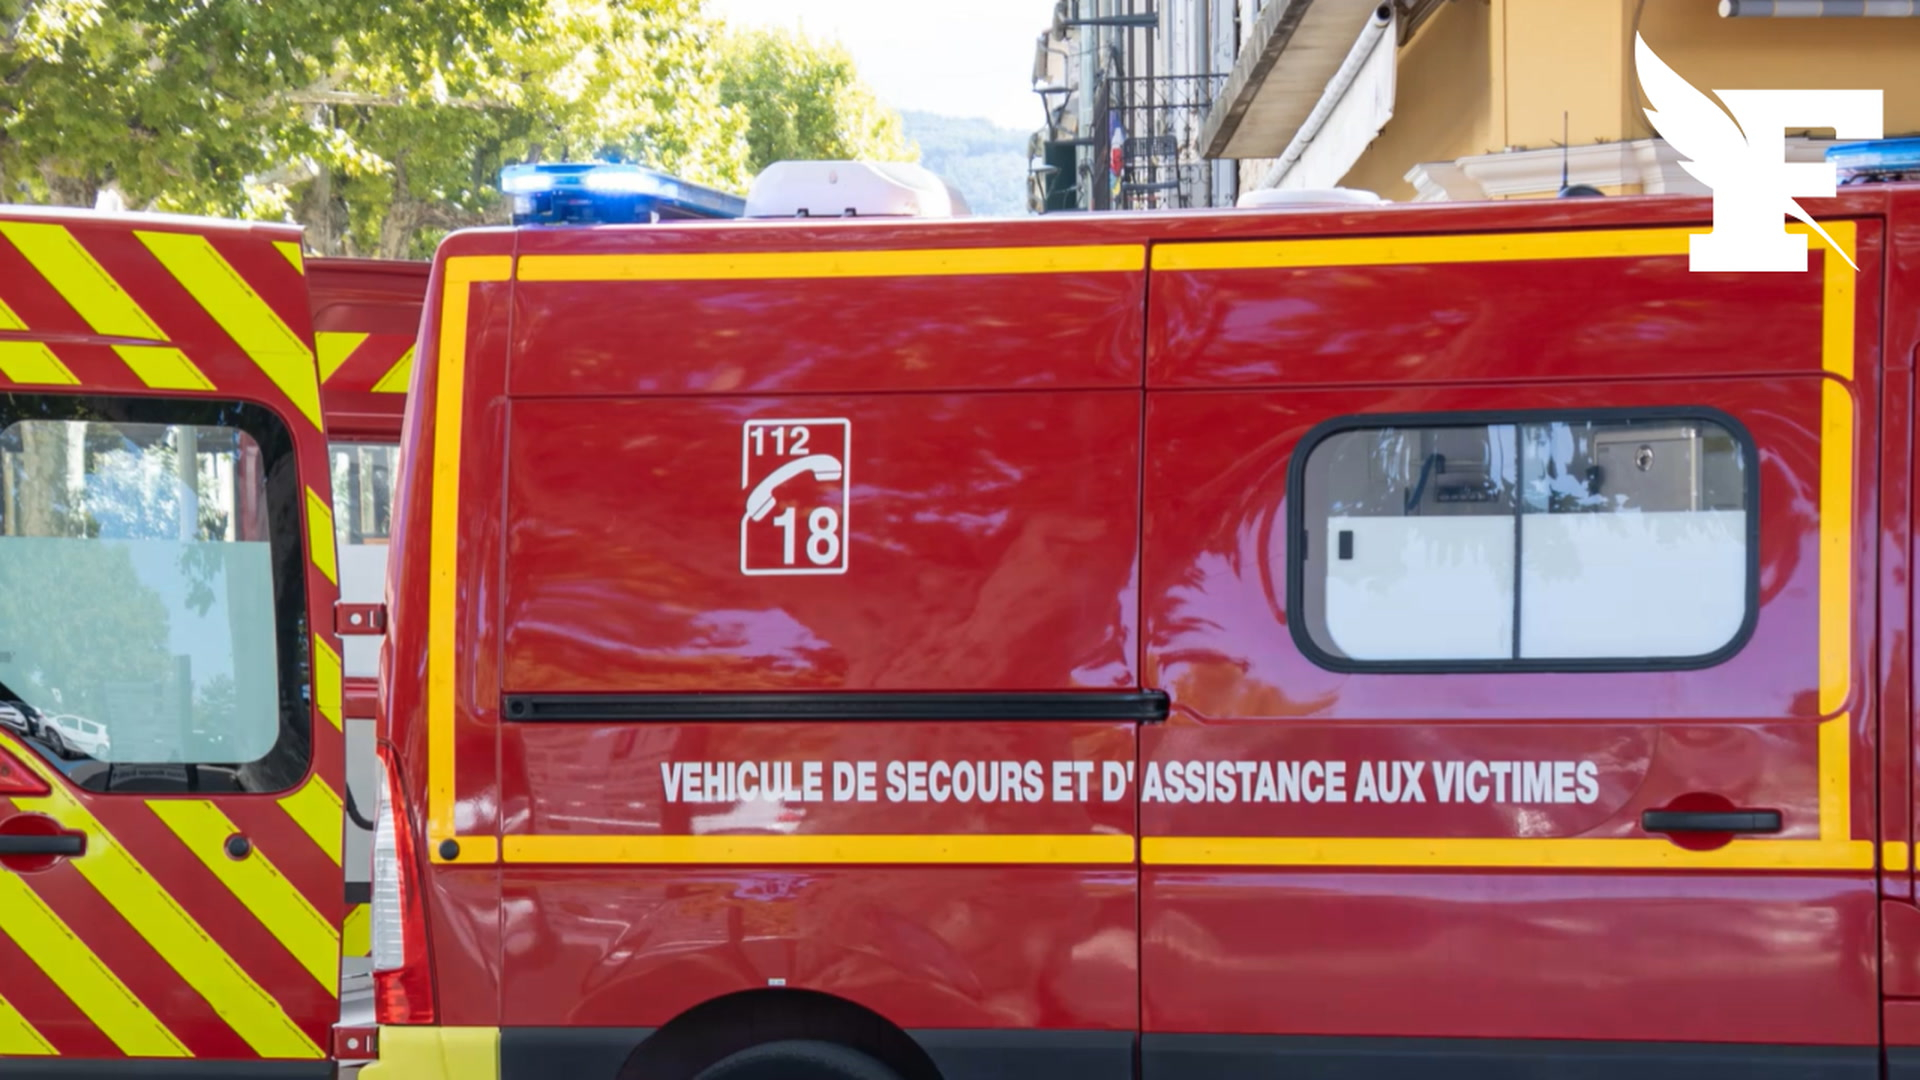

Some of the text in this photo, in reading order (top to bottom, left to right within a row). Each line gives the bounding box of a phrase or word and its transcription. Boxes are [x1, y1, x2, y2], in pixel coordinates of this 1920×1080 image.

[750, 426, 810, 456] 112
[773, 506, 839, 565] 18
[661, 761, 823, 802] VEHICULE
[833, 761, 878, 802] DE
[886, 760, 1044, 803] SECOURS
[1053, 761, 1094, 802] ET
[1354, 761, 1426, 803] AUX
[1432, 760, 1600, 803] VICTIMES
